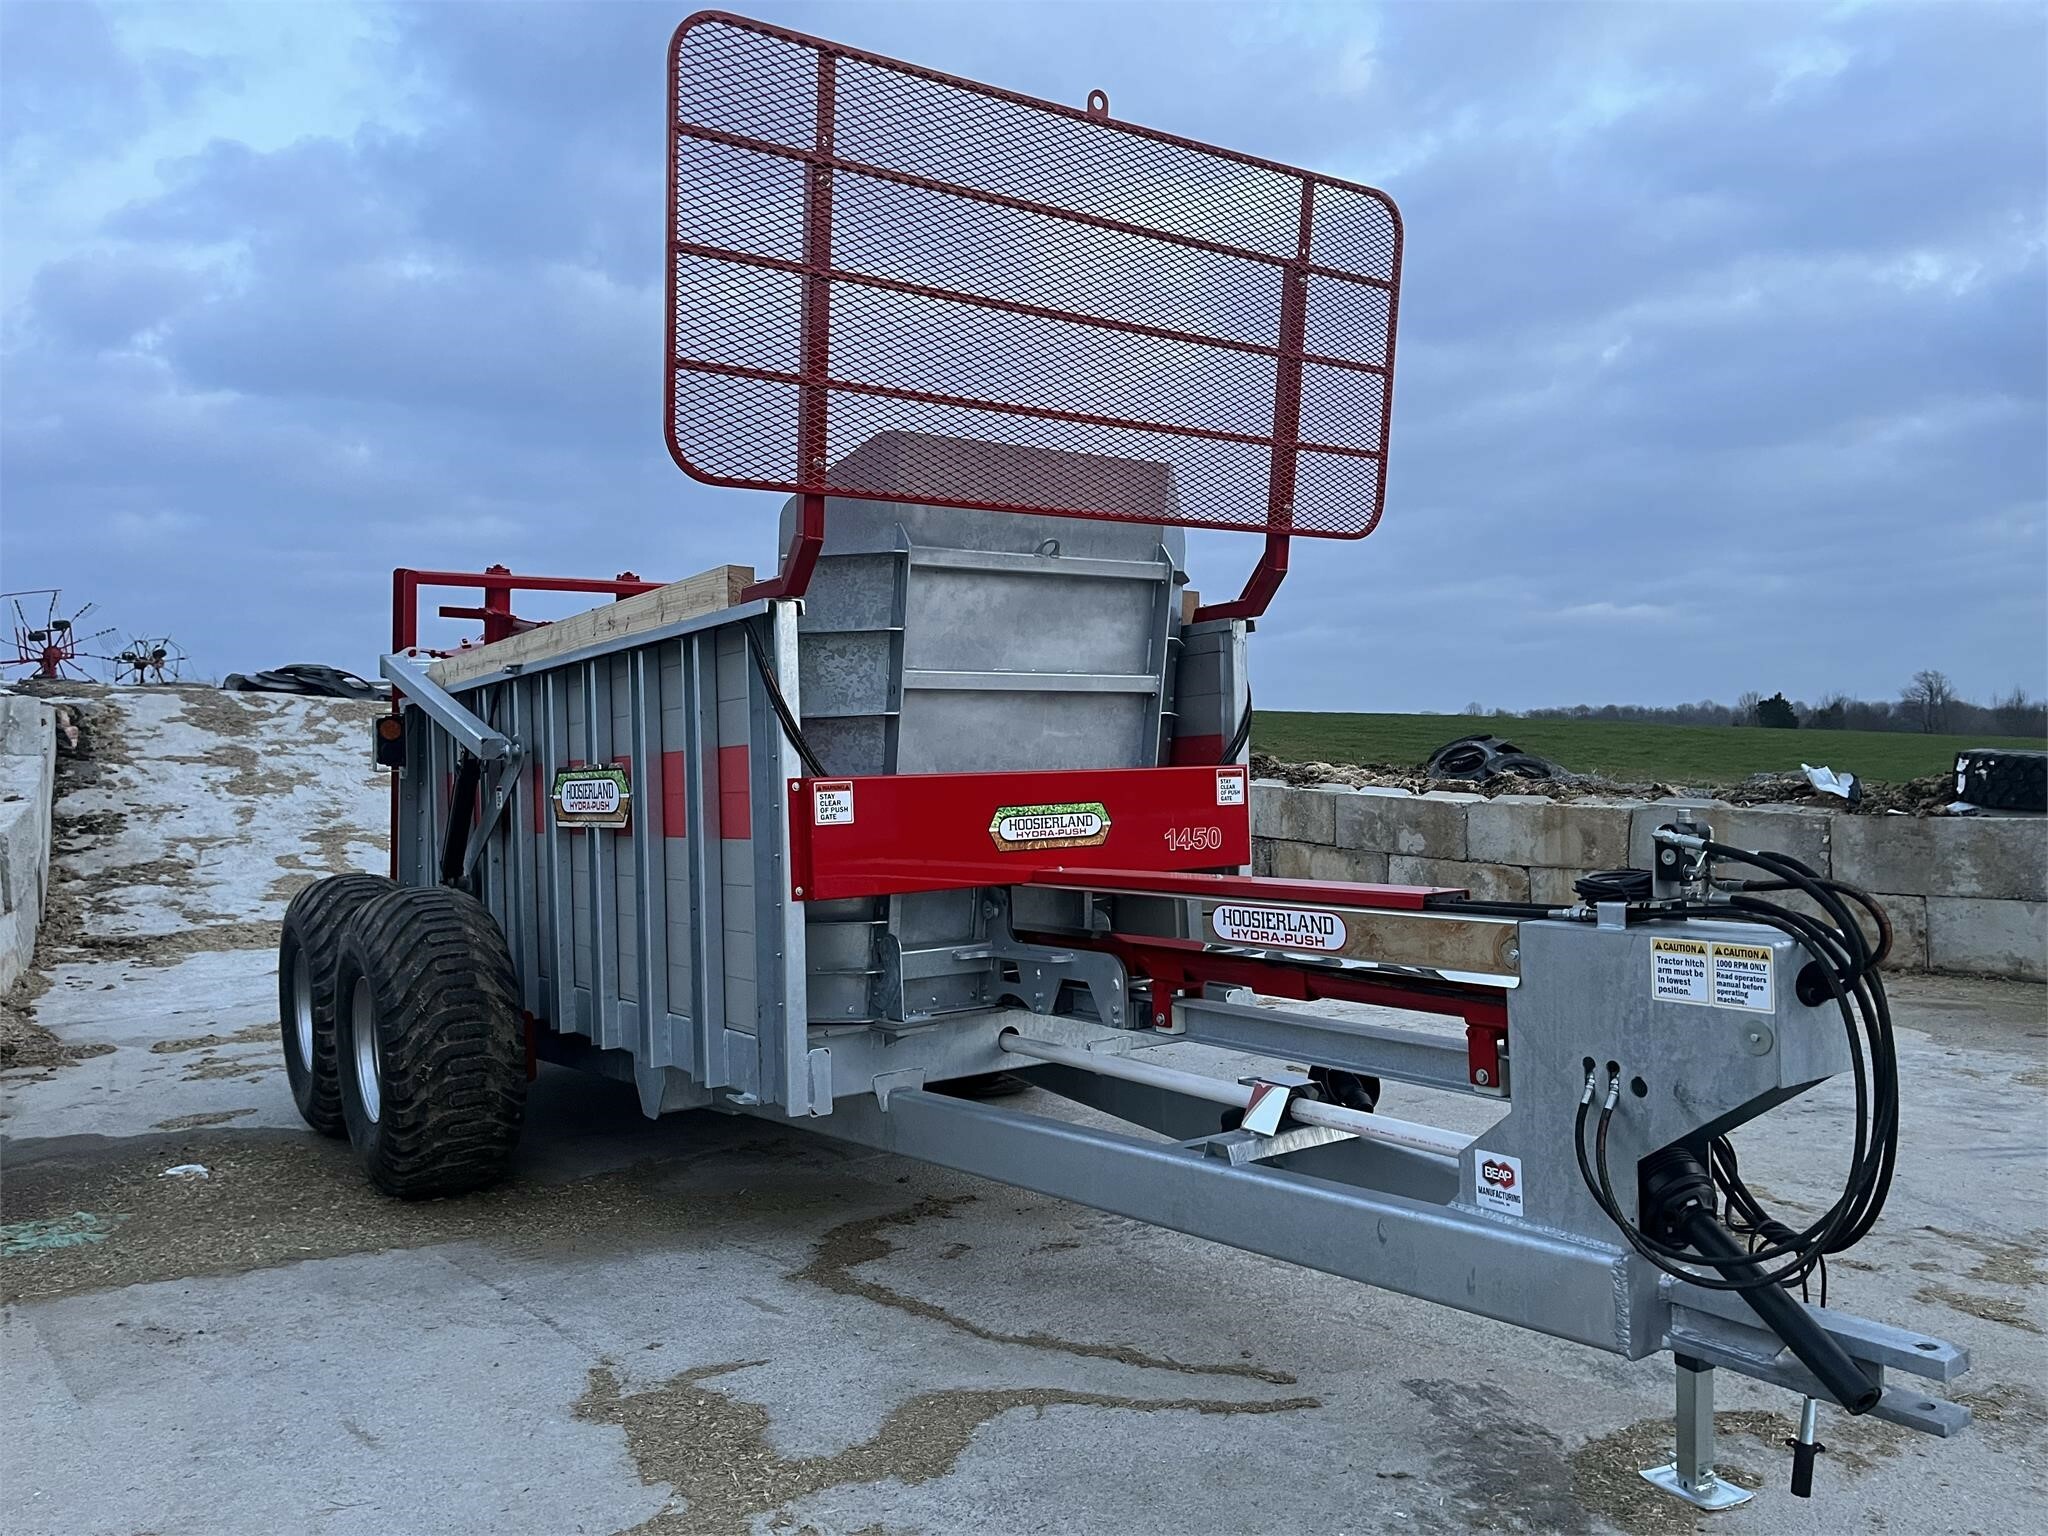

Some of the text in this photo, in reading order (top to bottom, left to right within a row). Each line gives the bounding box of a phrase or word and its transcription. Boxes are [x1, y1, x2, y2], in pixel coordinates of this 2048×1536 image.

[566, 783, 614, 800] HOOSIERLAND
[570, 801, 610, 811] HYDRA-PUSH
[1009, 815, 1093, 831] HOOSIERLAND
[1016, 828, 1087, 838] HYDRA-PUSH
[1164, 826, 1222, 851] 1450
[1222, 908, 1334, 935] HOOSIERLAND
[1231, 928, 1325, 947] HYDRA-PUSH
[1663, 943, 1697, 953] CAUTION
[1724, 947, 1759, 958] CAUTION
[1657, 956, 1705, 968] Tractor hitch
[1716, 960, 1767, 972] 1000 RPM ONLY
[1674, 968, 1692, 977] must
[1694, 969, 1704, 978] be
[1716, 972, 1767, 984] Read operators
[1667, 977, 1691, 986] lowest
[1716, 980, 1764, 991] manual before
[1658, 985, 1691, 996] position.
[1716, 989, 1748, 998] operating
[1717, 996, 1747, 1005] machine.
[1477, 1185, 1521, 1204] MANUFACTURING
